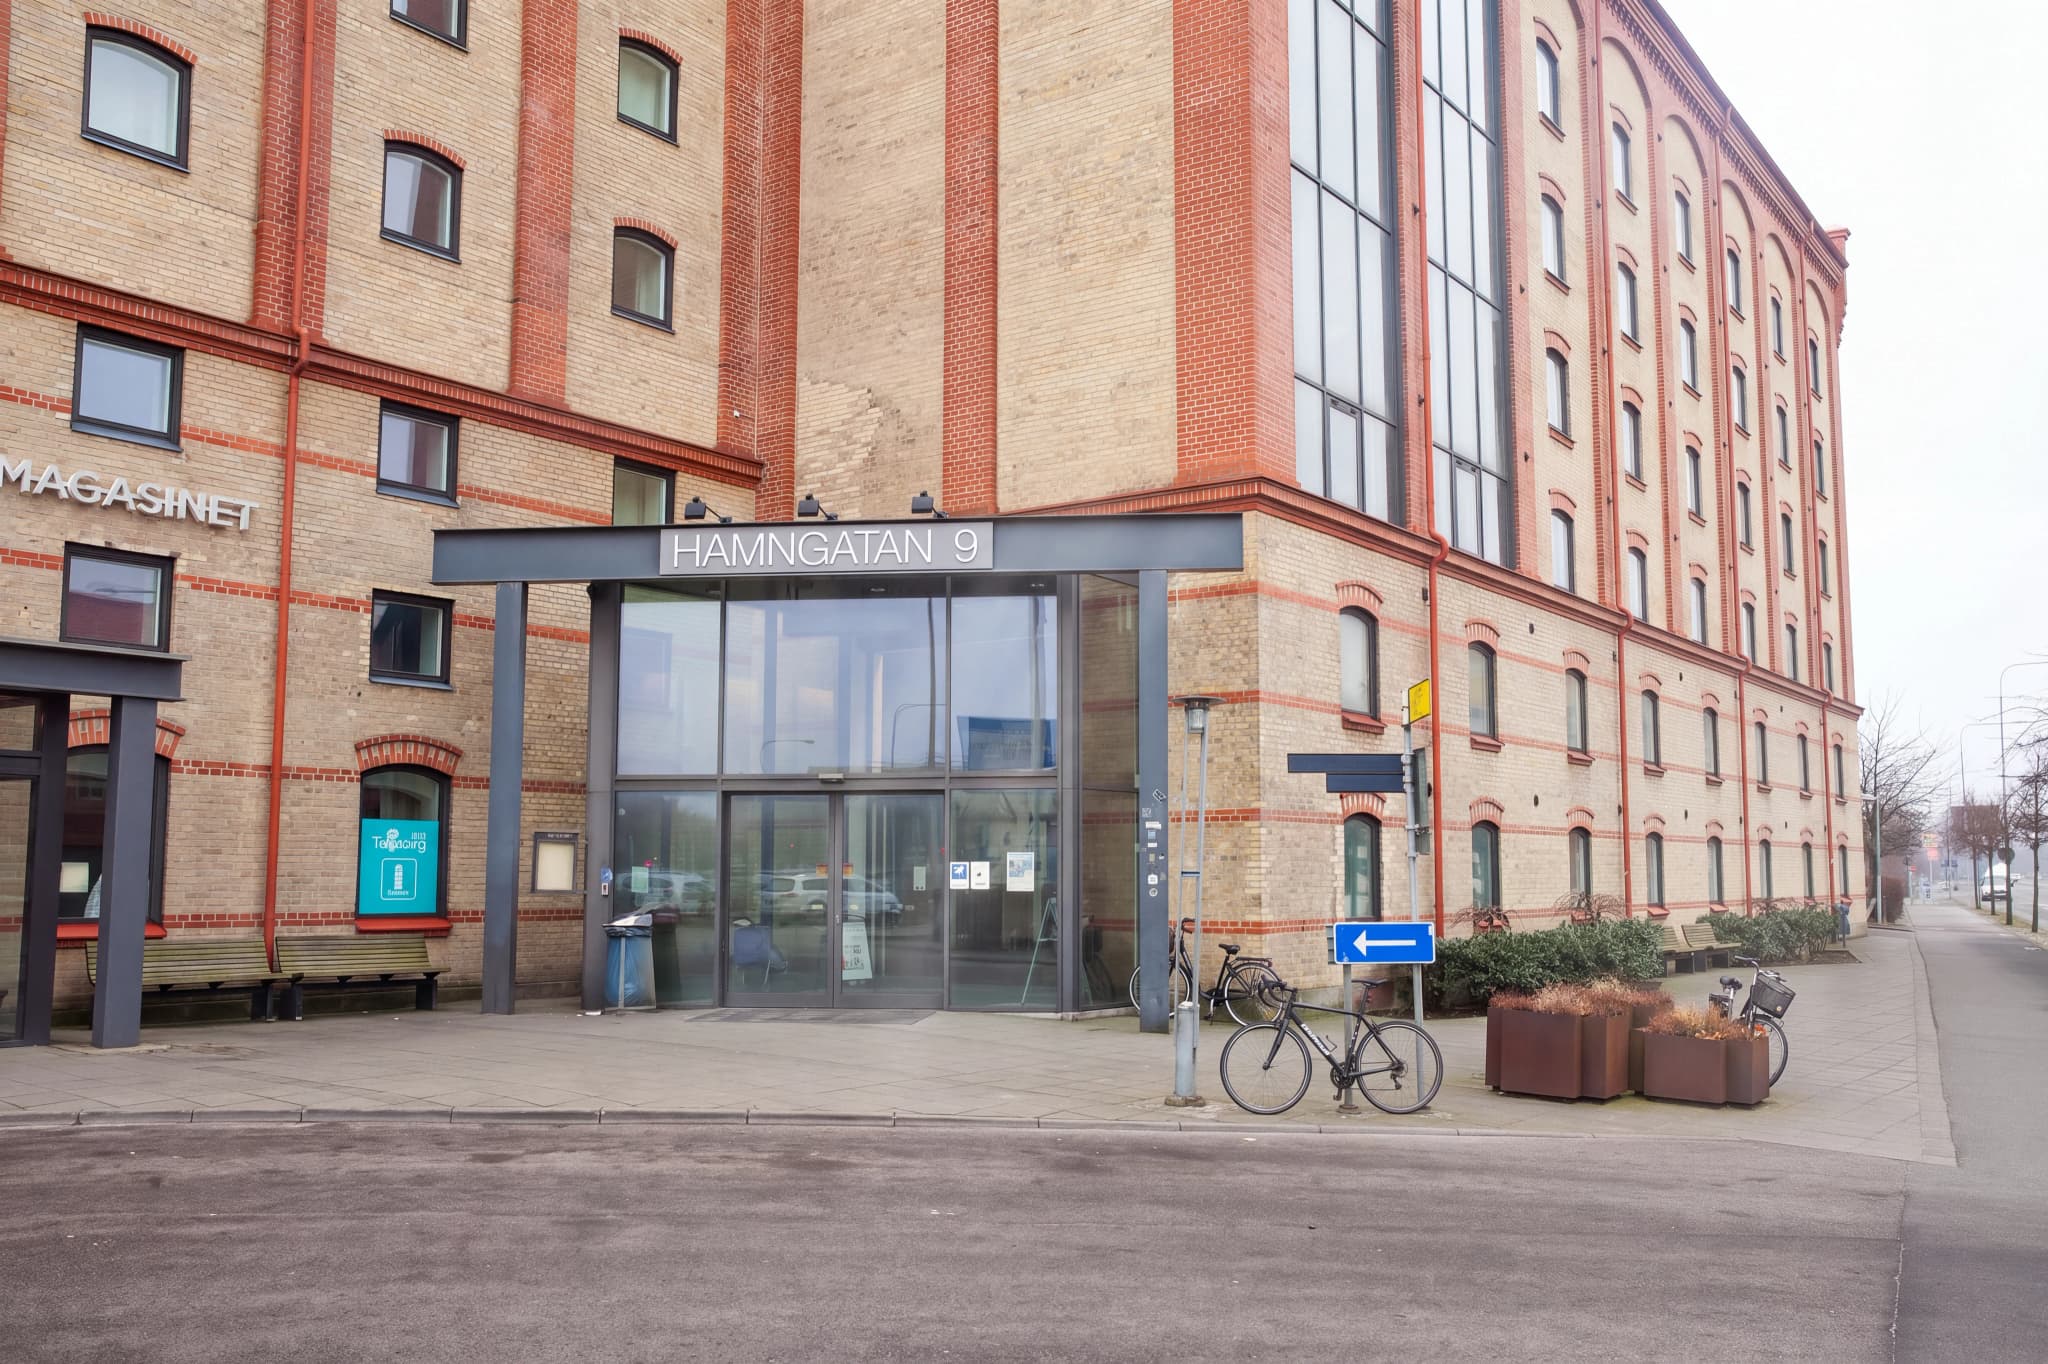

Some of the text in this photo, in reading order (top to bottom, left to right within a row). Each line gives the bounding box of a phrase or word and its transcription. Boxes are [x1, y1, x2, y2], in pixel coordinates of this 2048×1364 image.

[0, 455, 259, 530] MAGASINET
[673, 529, 978, 568] HAMNGATAN 9
